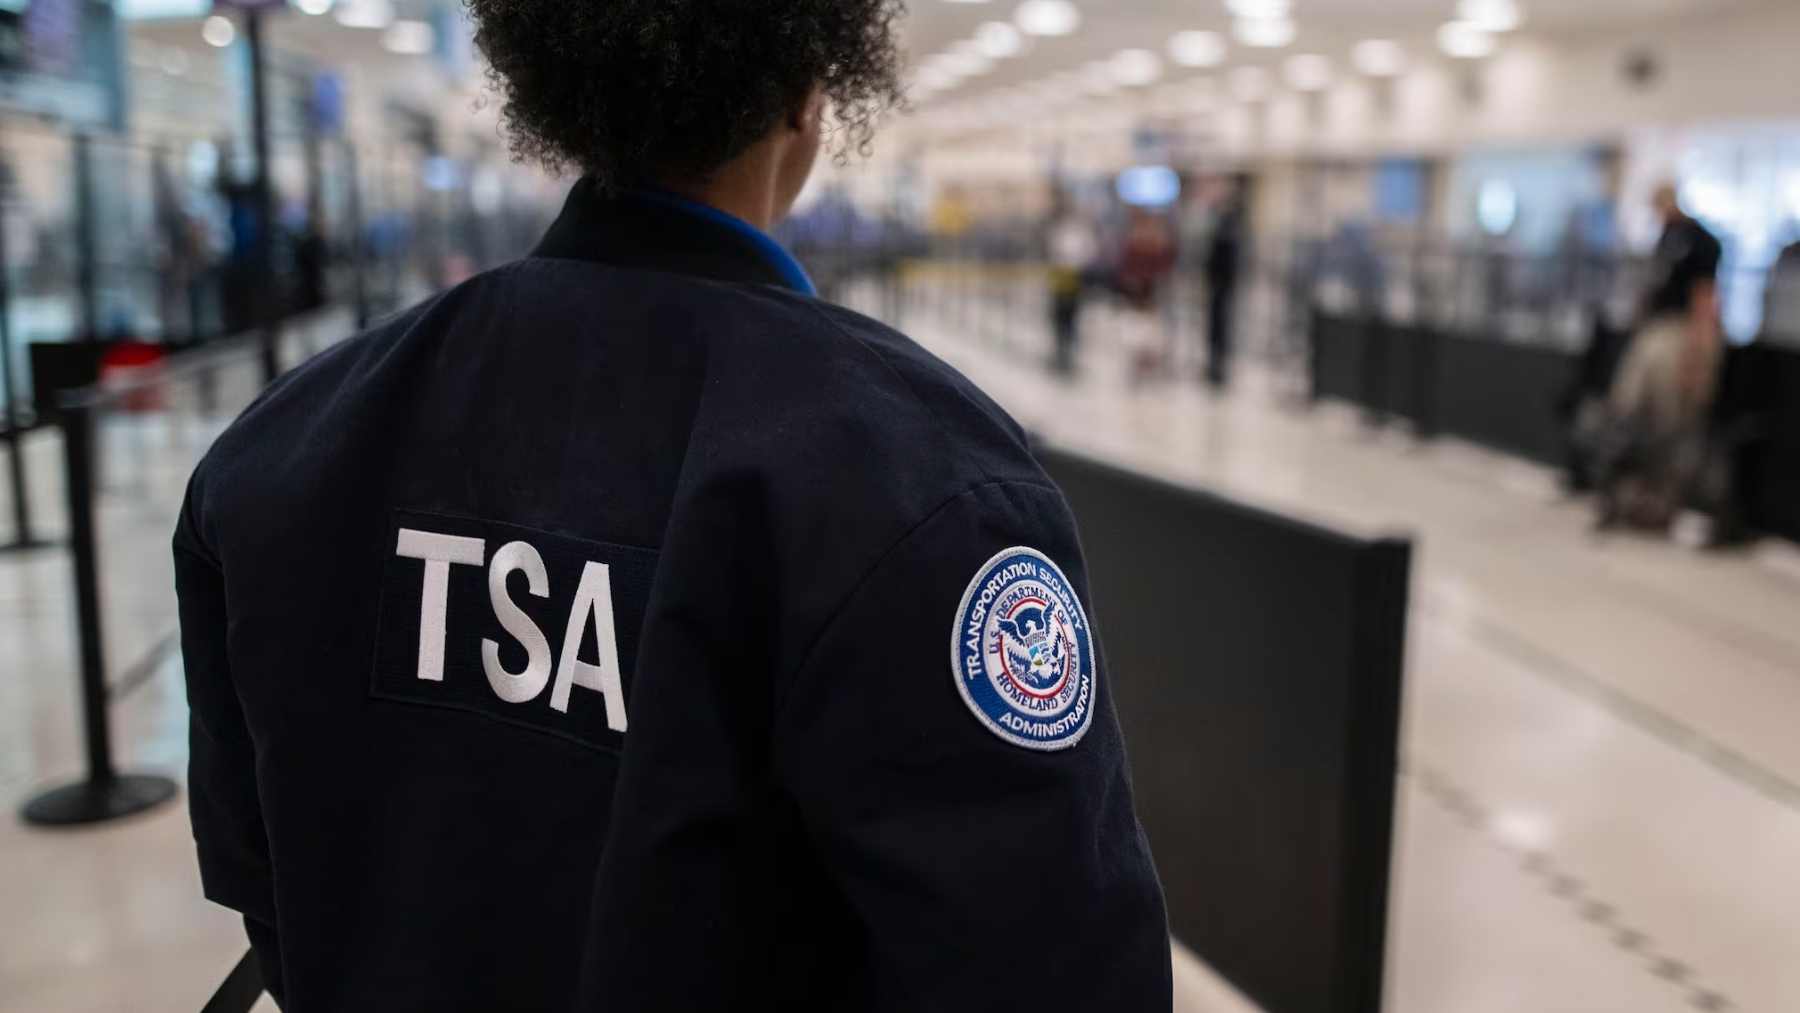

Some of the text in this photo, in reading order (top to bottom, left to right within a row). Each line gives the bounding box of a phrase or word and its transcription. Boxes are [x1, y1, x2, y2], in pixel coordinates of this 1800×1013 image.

[396, 528, 628, 733] TSA
[966, 562, 1083, 680] TRANSPORTATION SECURITY
[1058, 609, 1069, 625] OF
[996, 672, 1058, 711] HOMELAND
[1000, 674, 1090, 737] ADMINISTRATION
